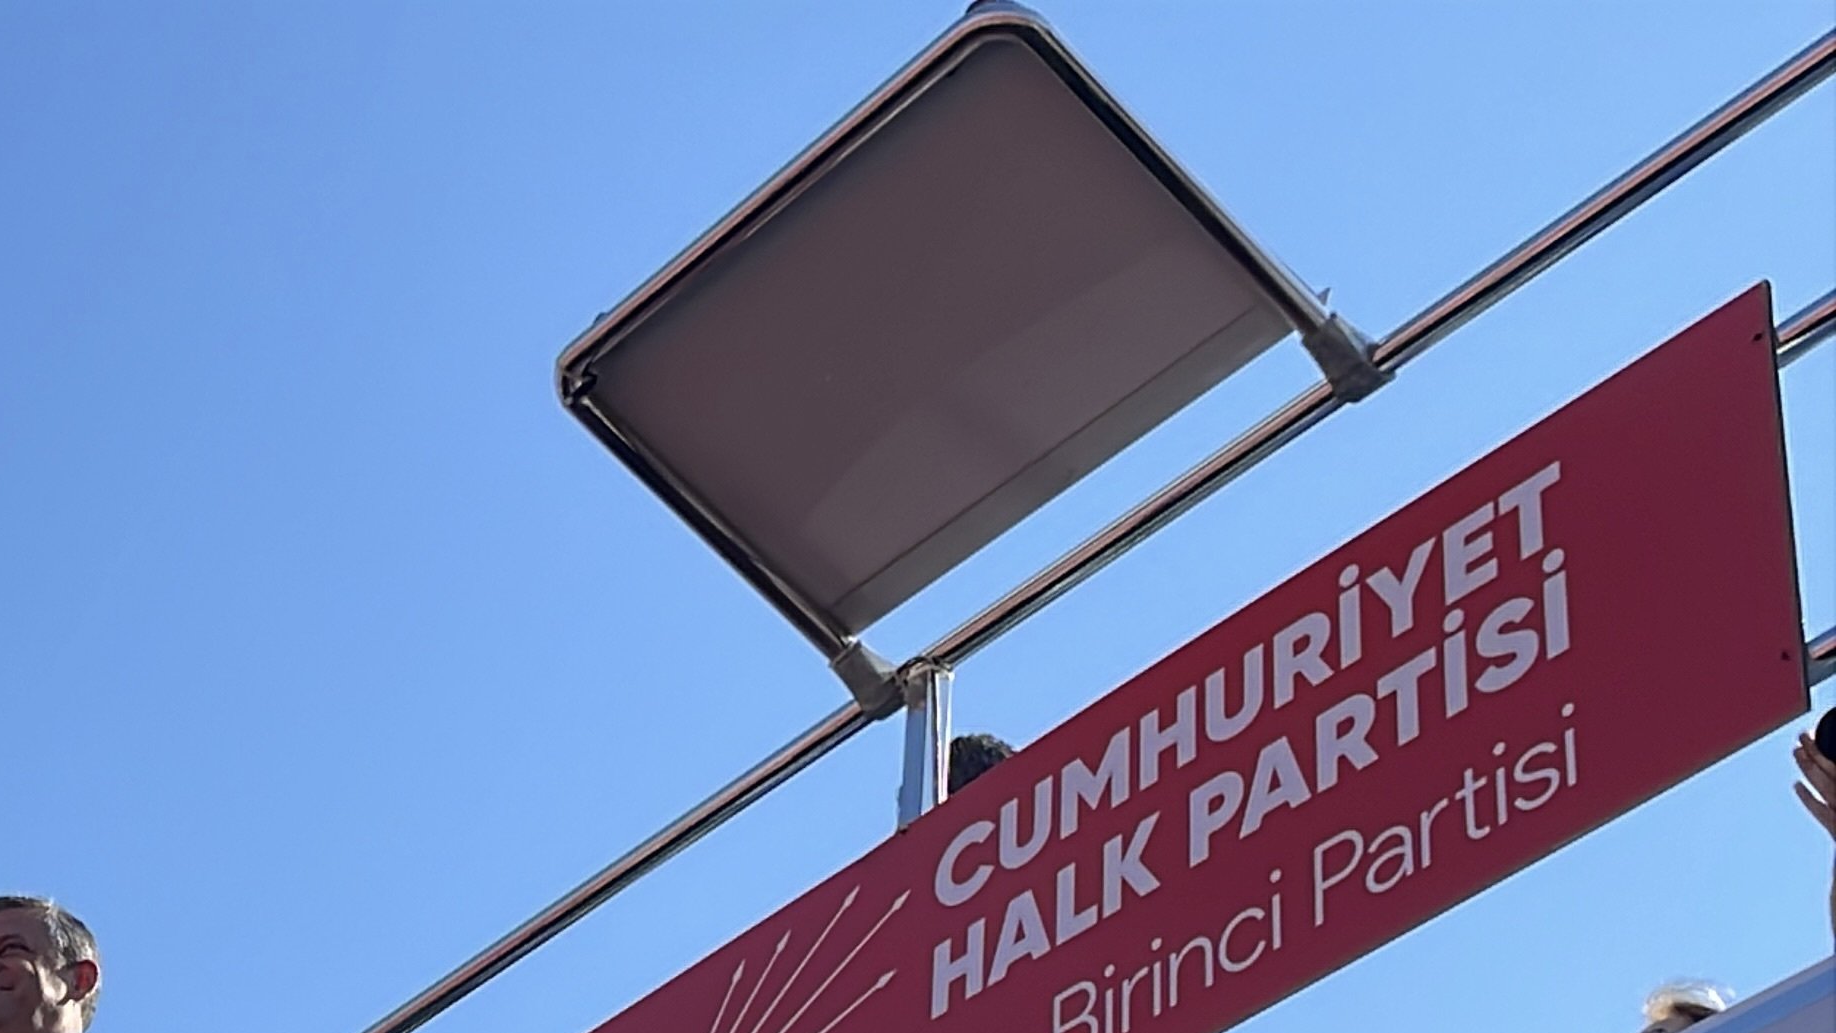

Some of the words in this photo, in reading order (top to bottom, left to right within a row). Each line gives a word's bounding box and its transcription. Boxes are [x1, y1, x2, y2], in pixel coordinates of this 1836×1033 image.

[930, 811, 1161, 1020] HALK
[1188, 548, 1570, 869] PARTİSİ
[933, 460, 1561, 908] CUMHURİYET
[1314, 702, 1578, 927] Partisi
